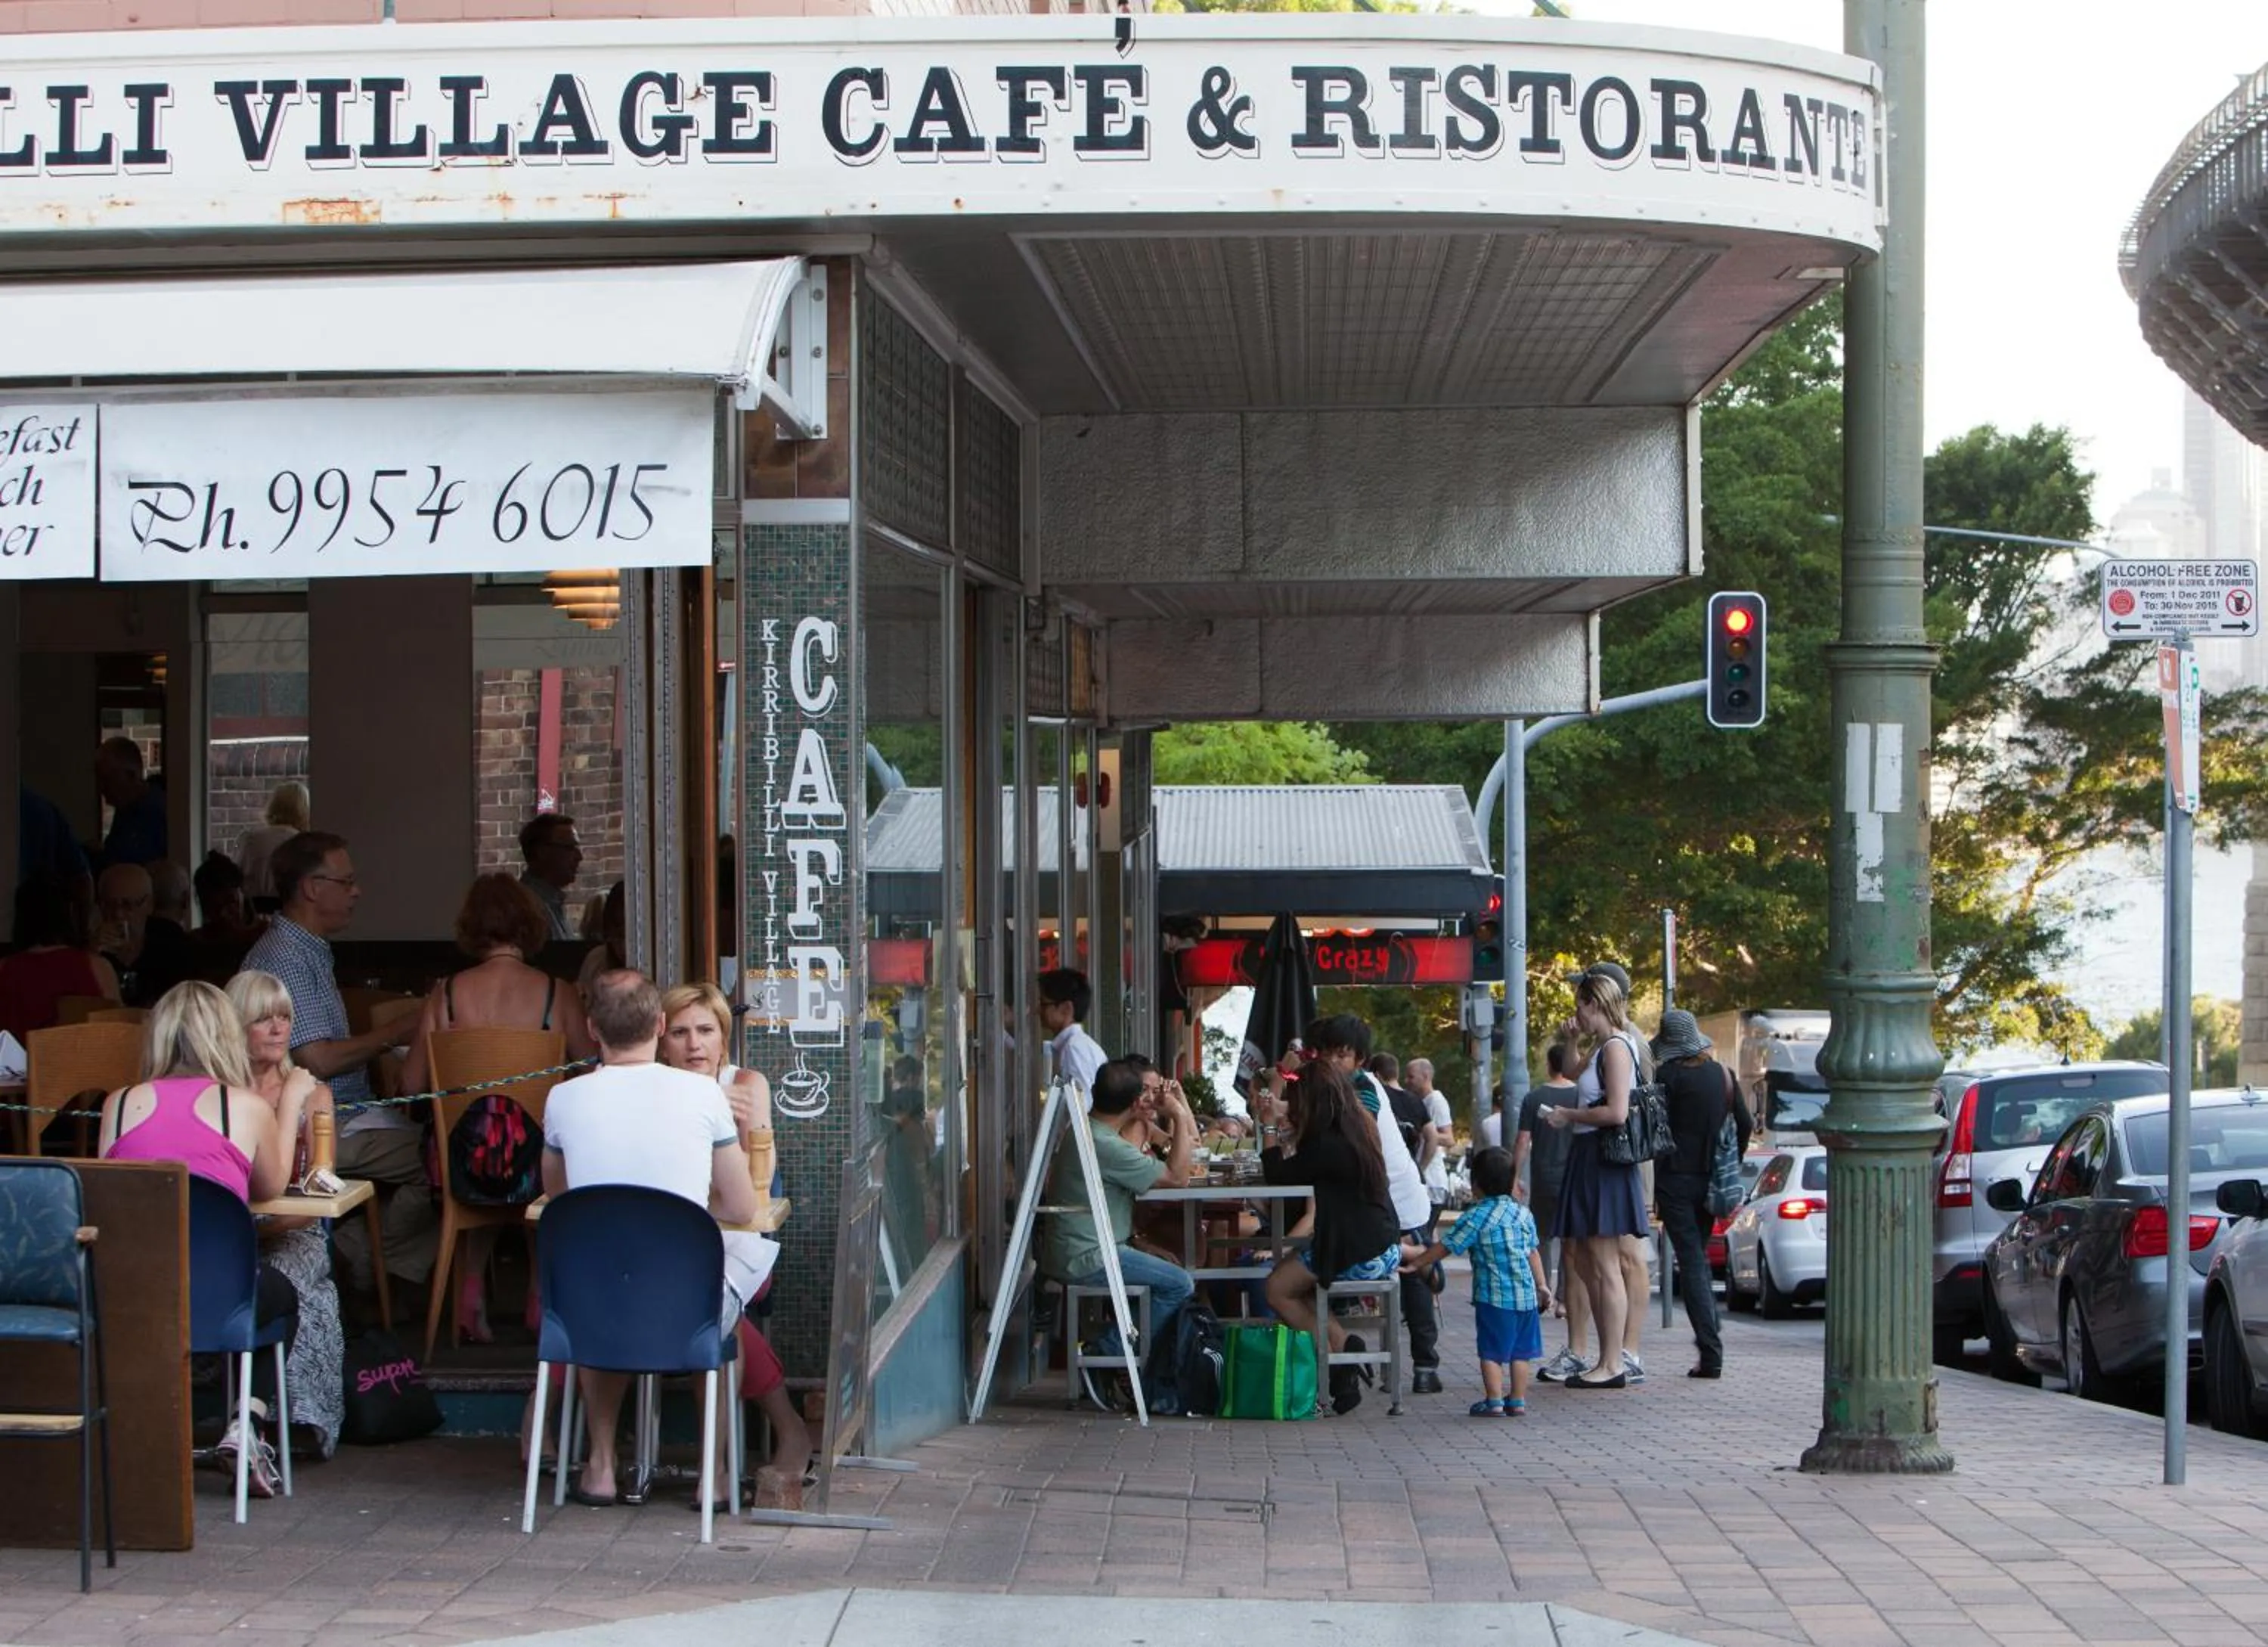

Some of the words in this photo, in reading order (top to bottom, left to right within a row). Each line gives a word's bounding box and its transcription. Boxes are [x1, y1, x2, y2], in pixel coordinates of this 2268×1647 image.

[214, 71, 776, 172] VILLAGE
[1187, 66, 1260, 159] &
[1291, 64, 1867, 199] RISTORANTE
[0, 523, 55, 556] er
[268, 465, 466, 554] 9954
[491, 464, 668, 541] 6015
[2140, 591, 2167, 599] From:
[2178, 591, 2197, 599] Dec
[2200, 591, 2220, 599] 2011
[2214, 565, 2251, 577] ZONE
[2144, 601, 2158, 610] To:
[2161, 601, 2174, 609] 30
[2174, 601, 2193, 610] Nov
[2195, 601, 2217, 609] 2015
[761, 619, 781, 856] KIRRIBILLI
[780, 616, 847, 1047] CAFE
[762, 870, 781, 1034] VILLAGE
[1318, 945, 1390, 974] Crazy
